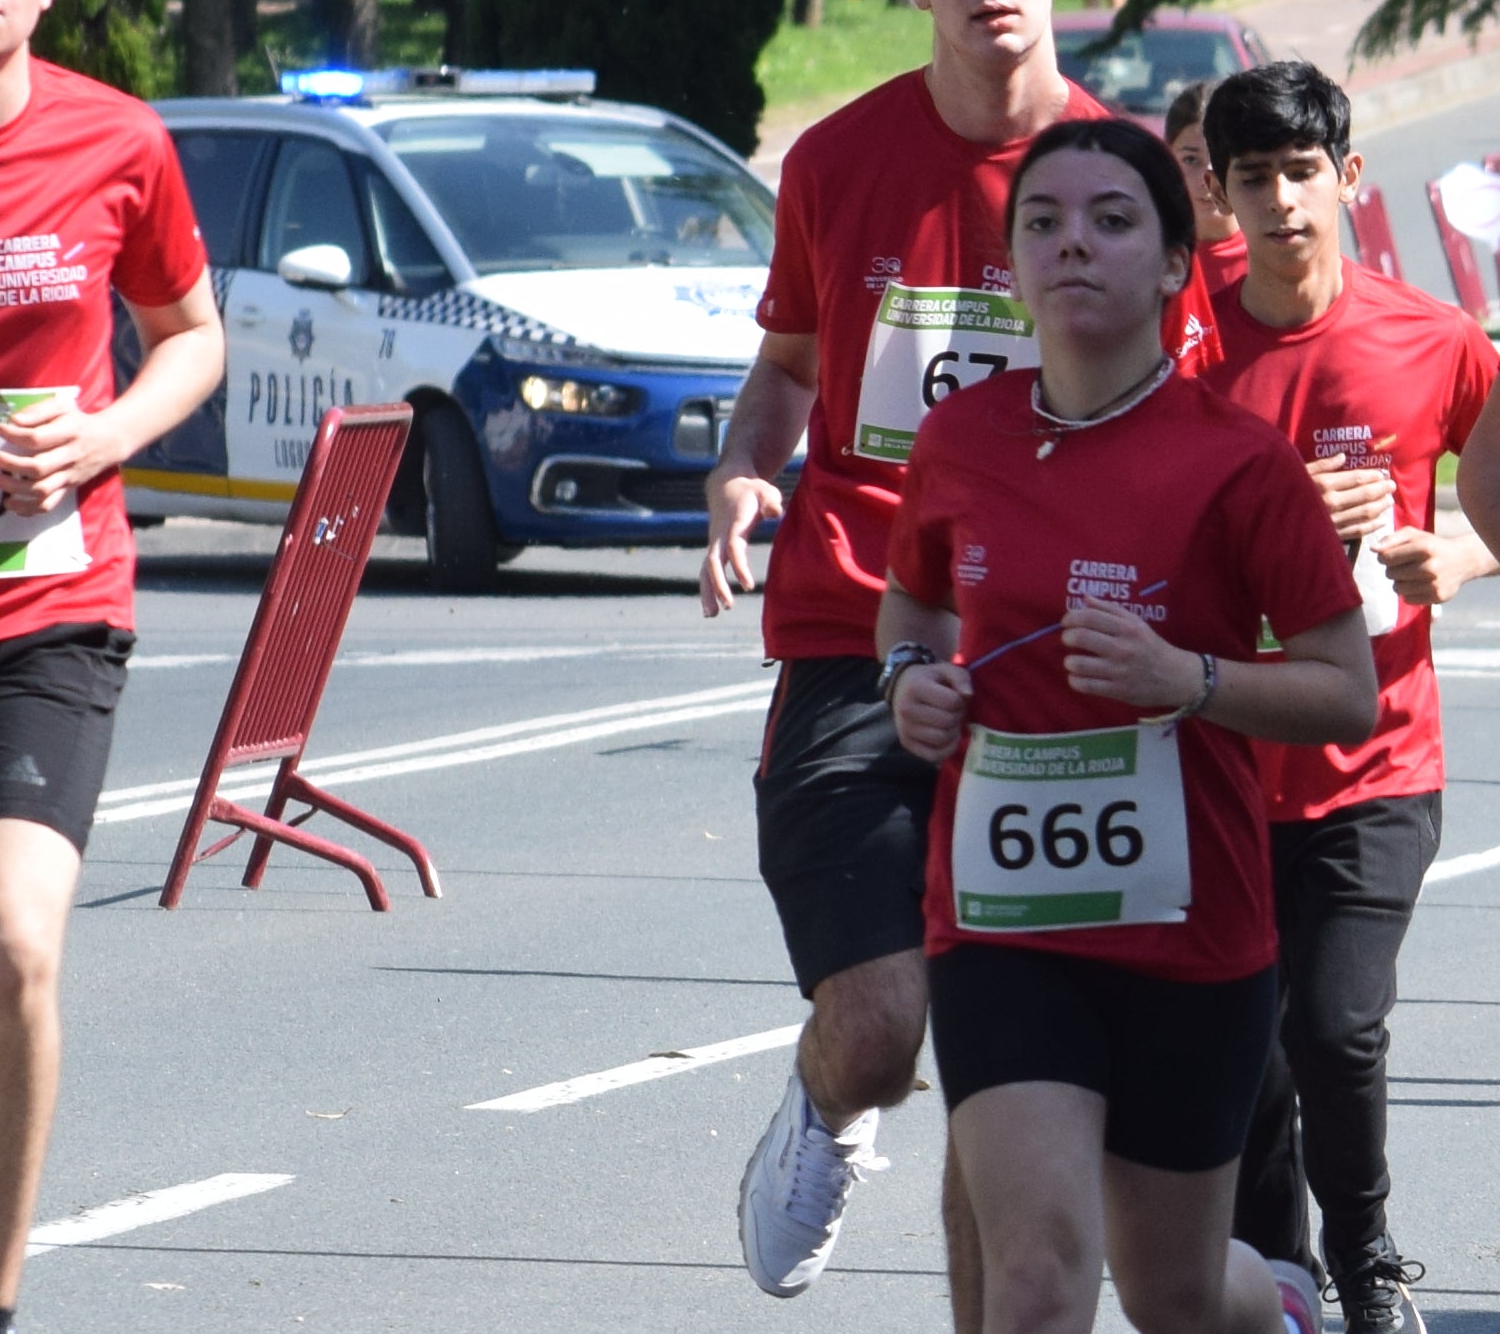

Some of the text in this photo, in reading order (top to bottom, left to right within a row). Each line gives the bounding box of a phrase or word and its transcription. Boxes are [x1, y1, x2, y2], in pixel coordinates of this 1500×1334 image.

[20, 288, 39, 304] LA
[41, 284, 80, 303] RIOJA
[890, 296, 990, 314] CARRERA CAMPUS
[886, 309, 1026, 332] UNIVERSIDAD DE LA RIOJA
[249, 367, 353, 427] POLICÍA
[1313, 425, 1372, 442] CARRERA
[1315, 442, 1366, 458] CAMPUS
[1070, 559, 1138, 581] CARRERA
[1067, 578, 1131, 600] CAMPUS
[1024, 745, 1080, 760] CAMPUS
[1050, 761, 1065, 776] DE
[1068, 760, 1085, 774] LA
[1088, 757, 1125, 773] RIOJA
[989, 800, 1143, 870] 666
